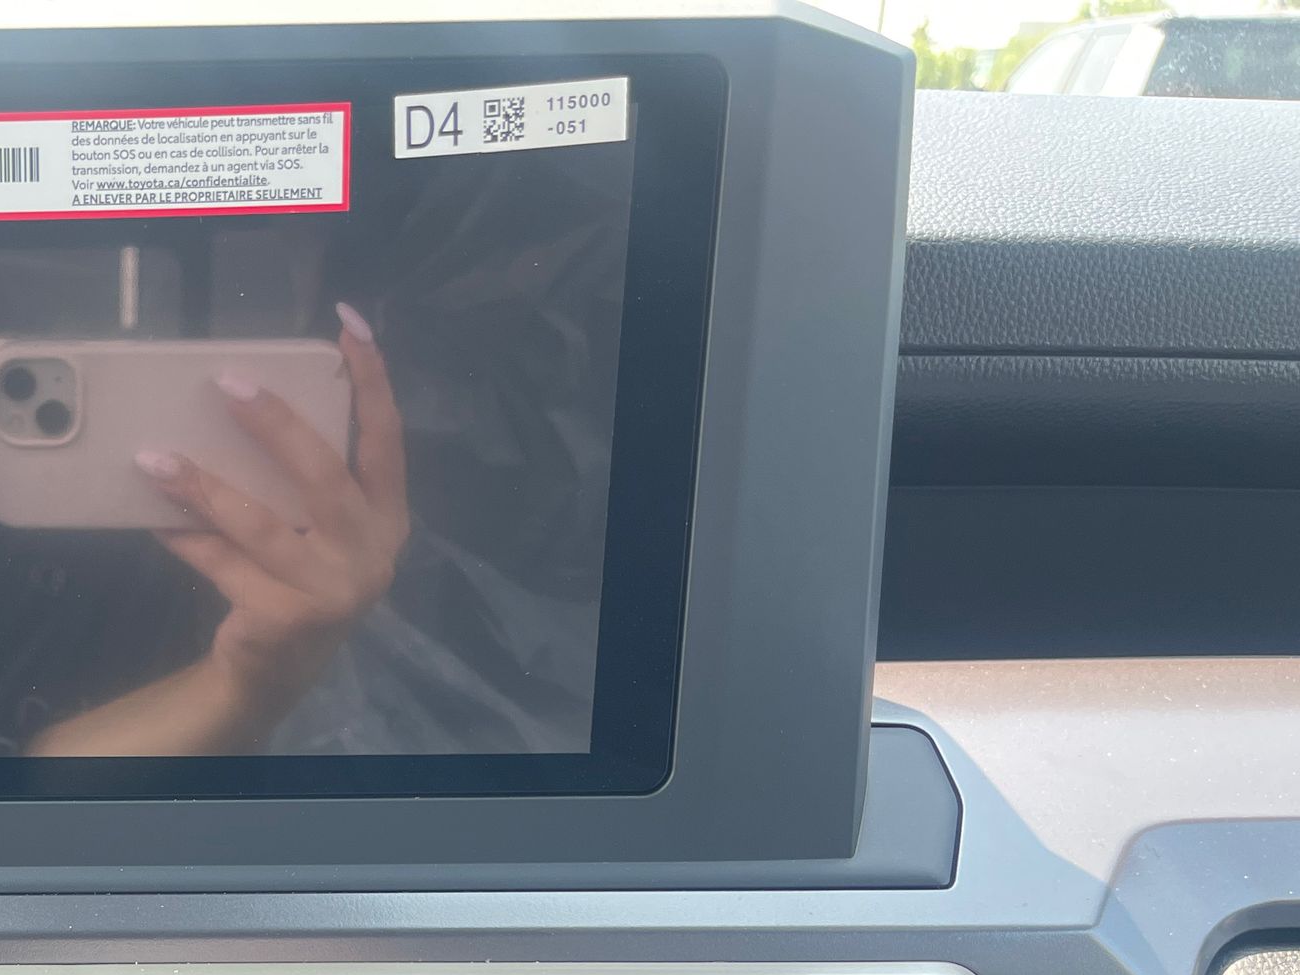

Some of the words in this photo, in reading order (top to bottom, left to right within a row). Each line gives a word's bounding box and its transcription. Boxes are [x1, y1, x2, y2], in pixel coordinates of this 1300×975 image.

[546, 92, 611, 111] 115000
[71, 120, 136, 133] REMARQUE:
[137, 119, 165, 130] Votre
[166, 117, 209, 129] véhicule
[211, 118, 235, 130] peut
[236, 116, 296, 127] transmettre
[297, 115, 321, 125] sans
[323, 112, 333, 124] fil
[405, 101, 464, 150] D4
[547, 119, 587, 135] -051
[71, 135, 91, 146] des
[93, 134, 139, 146] données
[141, 133, 155, 145] de
[157, 132, 218, 144] localisation
[220, 133, 233, 142] en
[235, 132, 286, 144] appuyant
[288, 130, 305, 140] sur
[307, 128, 317, 140] le
[72, 150, 110, 161] bouton
[113, 149, 136, 160] SOS
[138, 151, 152, 159] ou
[154, 150, 168, 159] en
[170, 149, 187, 158] cas
[190, 147, 204, 158] de
[205, 145, 253, 158] collision.
[255, 145, 280, 156] Pour
[281, 143, 317, 155] arrêter
[319, 142, 329, 154] la
[72, 164, 141, 176] transmission,
[144, 162, 200, 174] demandez
[202, 162, 208, 172] à
[211, 163, 225, 172] un
[227, 161, 259, 173] agent
[260, 160, 275, 170] via
[277, 159, 303, 170] SOS.
[72, 179, 94, 190] Voir
[96, 175, 270, 191] www.toyota.ca/confidentialite.
[72, 194, 80, 206] A
[83, 193, 132, 205] ENLEVER
[135, 193, 156, 205] PAR
[159, 192, 171, 204] LE
[175, 190, 253, 203] PROPRIETAIRE
[255, 188, 322, 201] SEULEMENT
